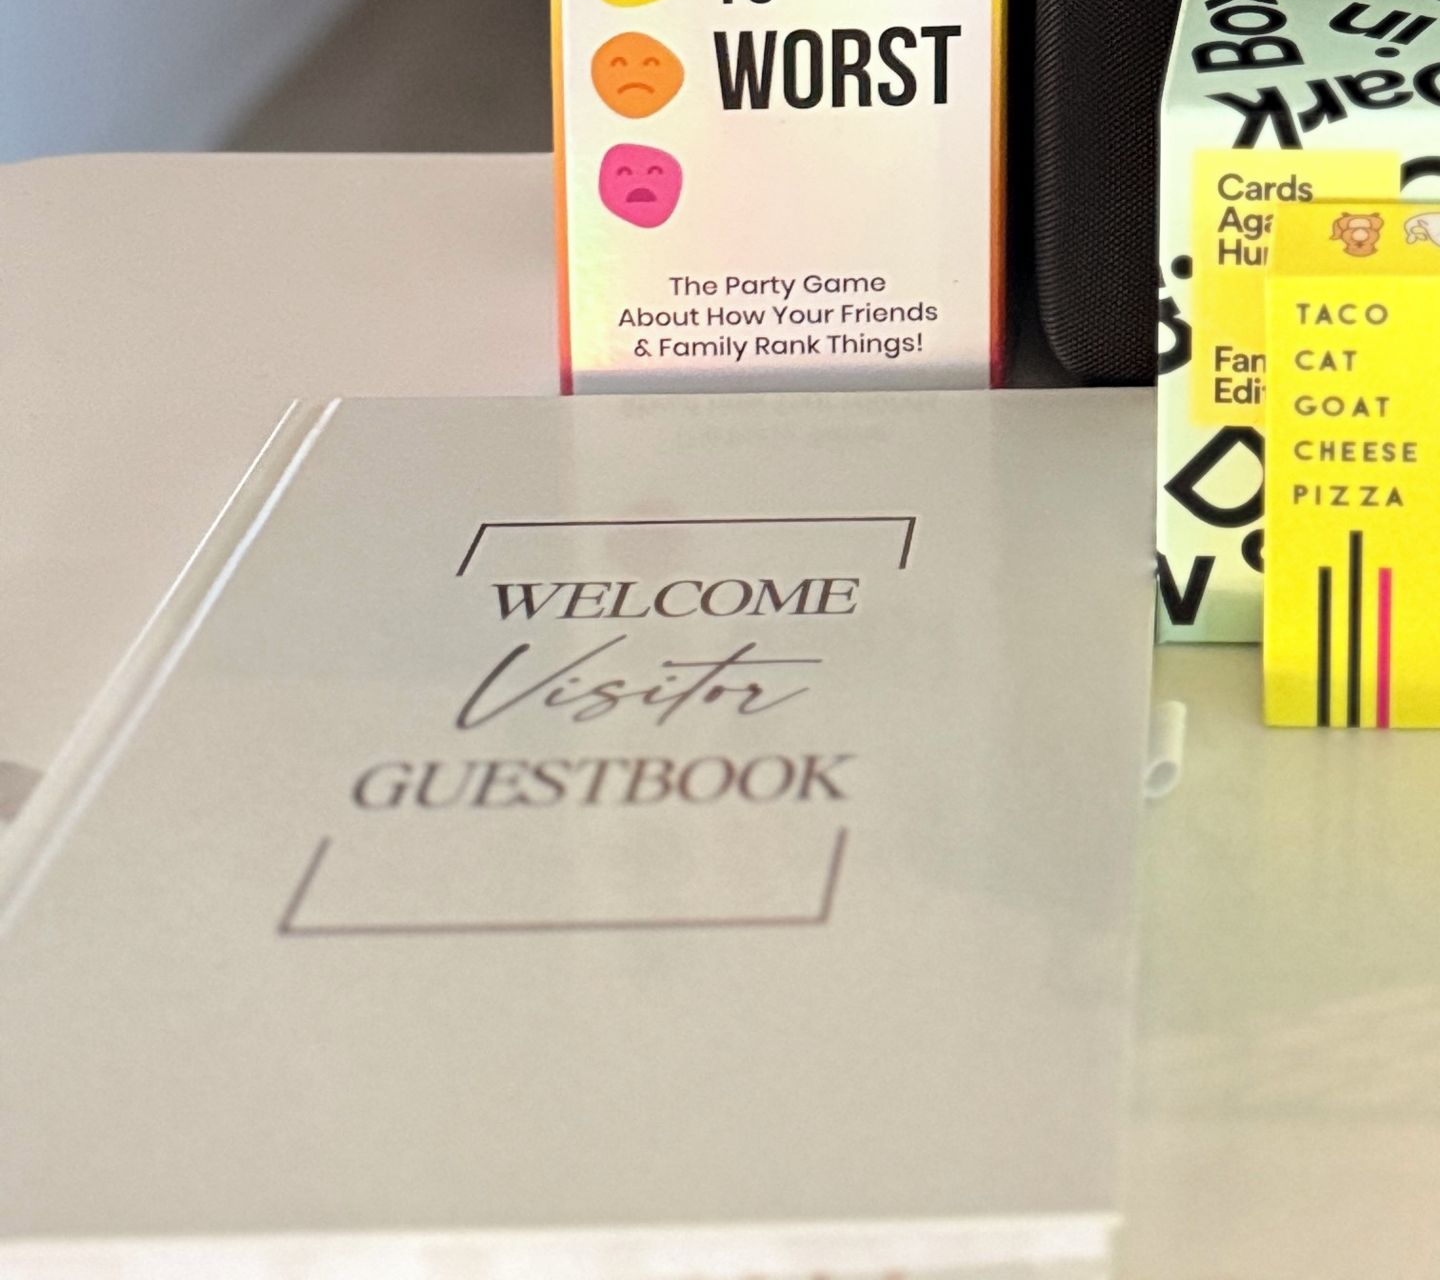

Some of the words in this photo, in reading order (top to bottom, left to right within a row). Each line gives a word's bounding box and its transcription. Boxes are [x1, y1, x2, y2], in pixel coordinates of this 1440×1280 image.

[713, 25, 962, 111] WORST
[1217, 173, 1313, 202] Cards
[669, 276, 718, 296] The
[725, 276, 796, 300] Party
[803, 274, 887, 294] Game
[618, 307, 700, 328] About
[707, 306, 765, 327] How
[772, 304, 834, 325] Your
[841, 301, 938, 322] Friends
[1296, 303, 1388, 326] TACO
[633, 338, 653, 357] &
[659, 336, 748, 362] Family
[755, 335, 820, 356] Rank
[827, 332, 923, 359] Things!
[1294, 349, 1358, 372] CAT
[1294, 395, 1390, 418] GOAT
[1294, 440, 1418, 463] CHEESE
[1293, 484, 1404, 507] PIZZA
[492, 577, 860, 621] WELCOME
[456, 634, 823, 730] Visitor
[351, 751, 857, 811] GUESTBOOK
